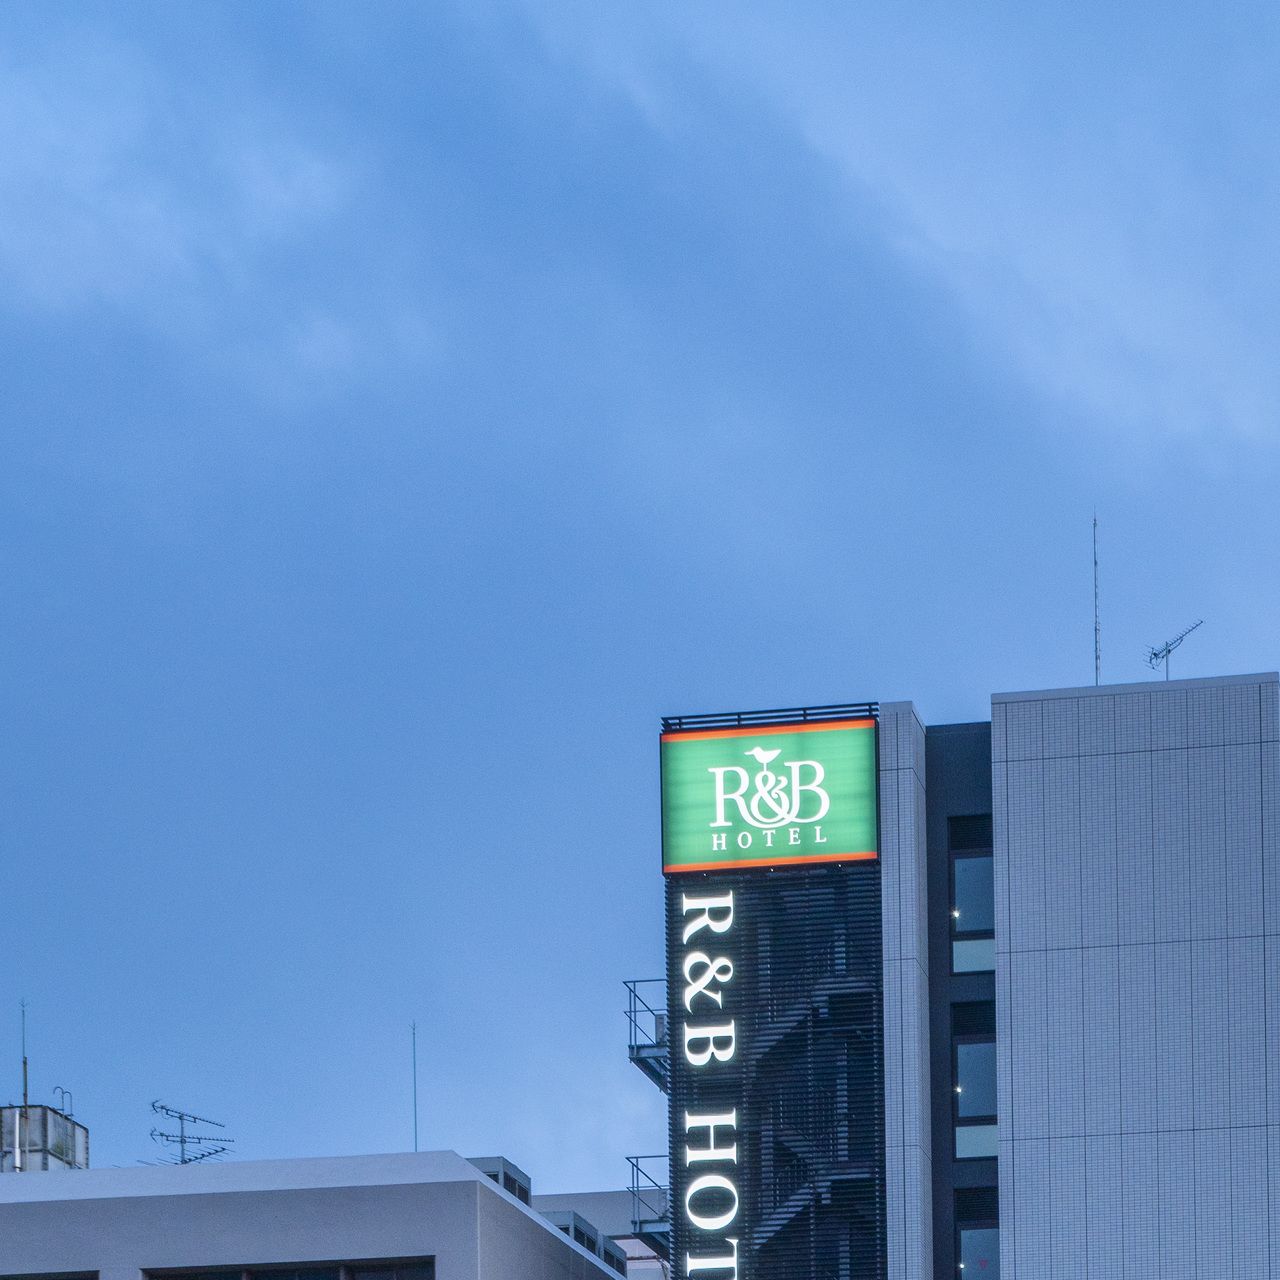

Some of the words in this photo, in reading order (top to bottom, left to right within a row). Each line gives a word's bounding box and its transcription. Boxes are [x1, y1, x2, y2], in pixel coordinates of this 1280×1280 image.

[708, 760, 831, 829] R&B
[711, 826, 827, 851] HOTEL
[682, 889, 736, 1066] R&B
